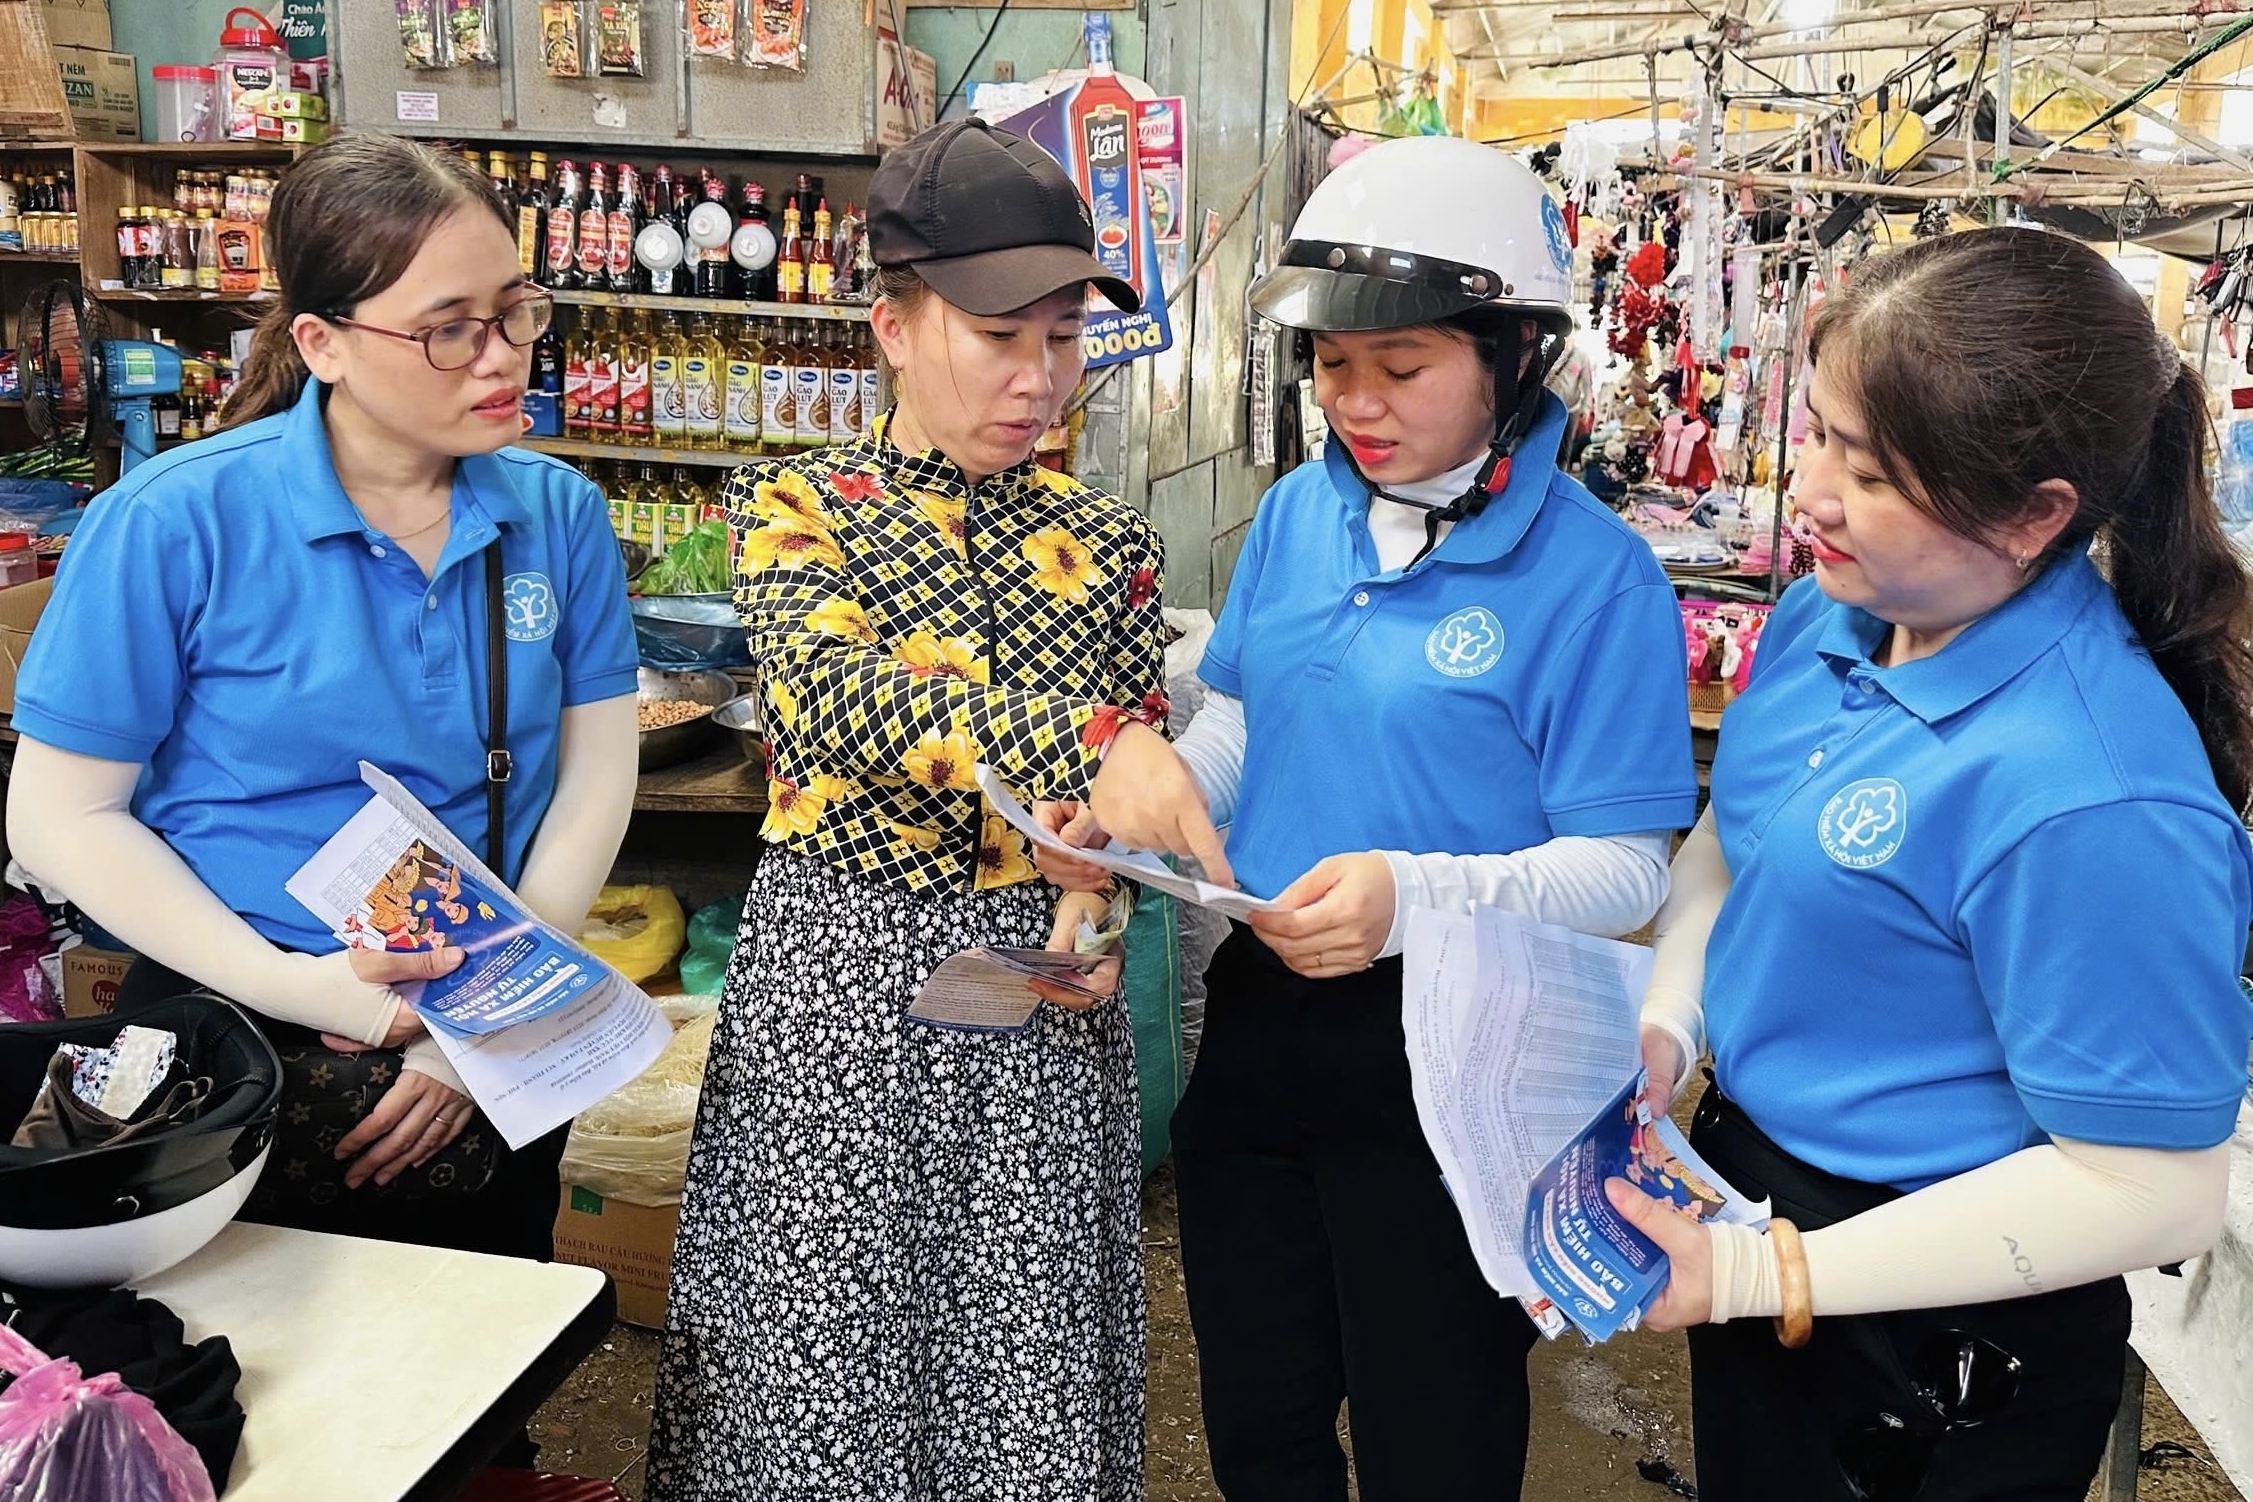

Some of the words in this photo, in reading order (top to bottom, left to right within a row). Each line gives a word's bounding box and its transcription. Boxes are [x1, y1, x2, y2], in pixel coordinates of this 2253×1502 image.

[1104, 250, 1126, 259] 40%
[1121, 312, 1153, 330] NGHỊ
[1876, 841, 1896, 862] NAM
[71, 962, 122, 976] FAMOUS
[532, 956, 560, 978] BẢO
[497, 976, 516, 991] TỰ
[499, 976, 534, 1001] HIỂM
[1559, 1214, 1591, 1260] HIỂM
[1572, 1217, 1591, 1241] TỰ
[588, 1242, 609, 1254] RAU
[647, 1269, 668, 1282] FRU
[1589, 1259, 1624, 1290] BẢO
